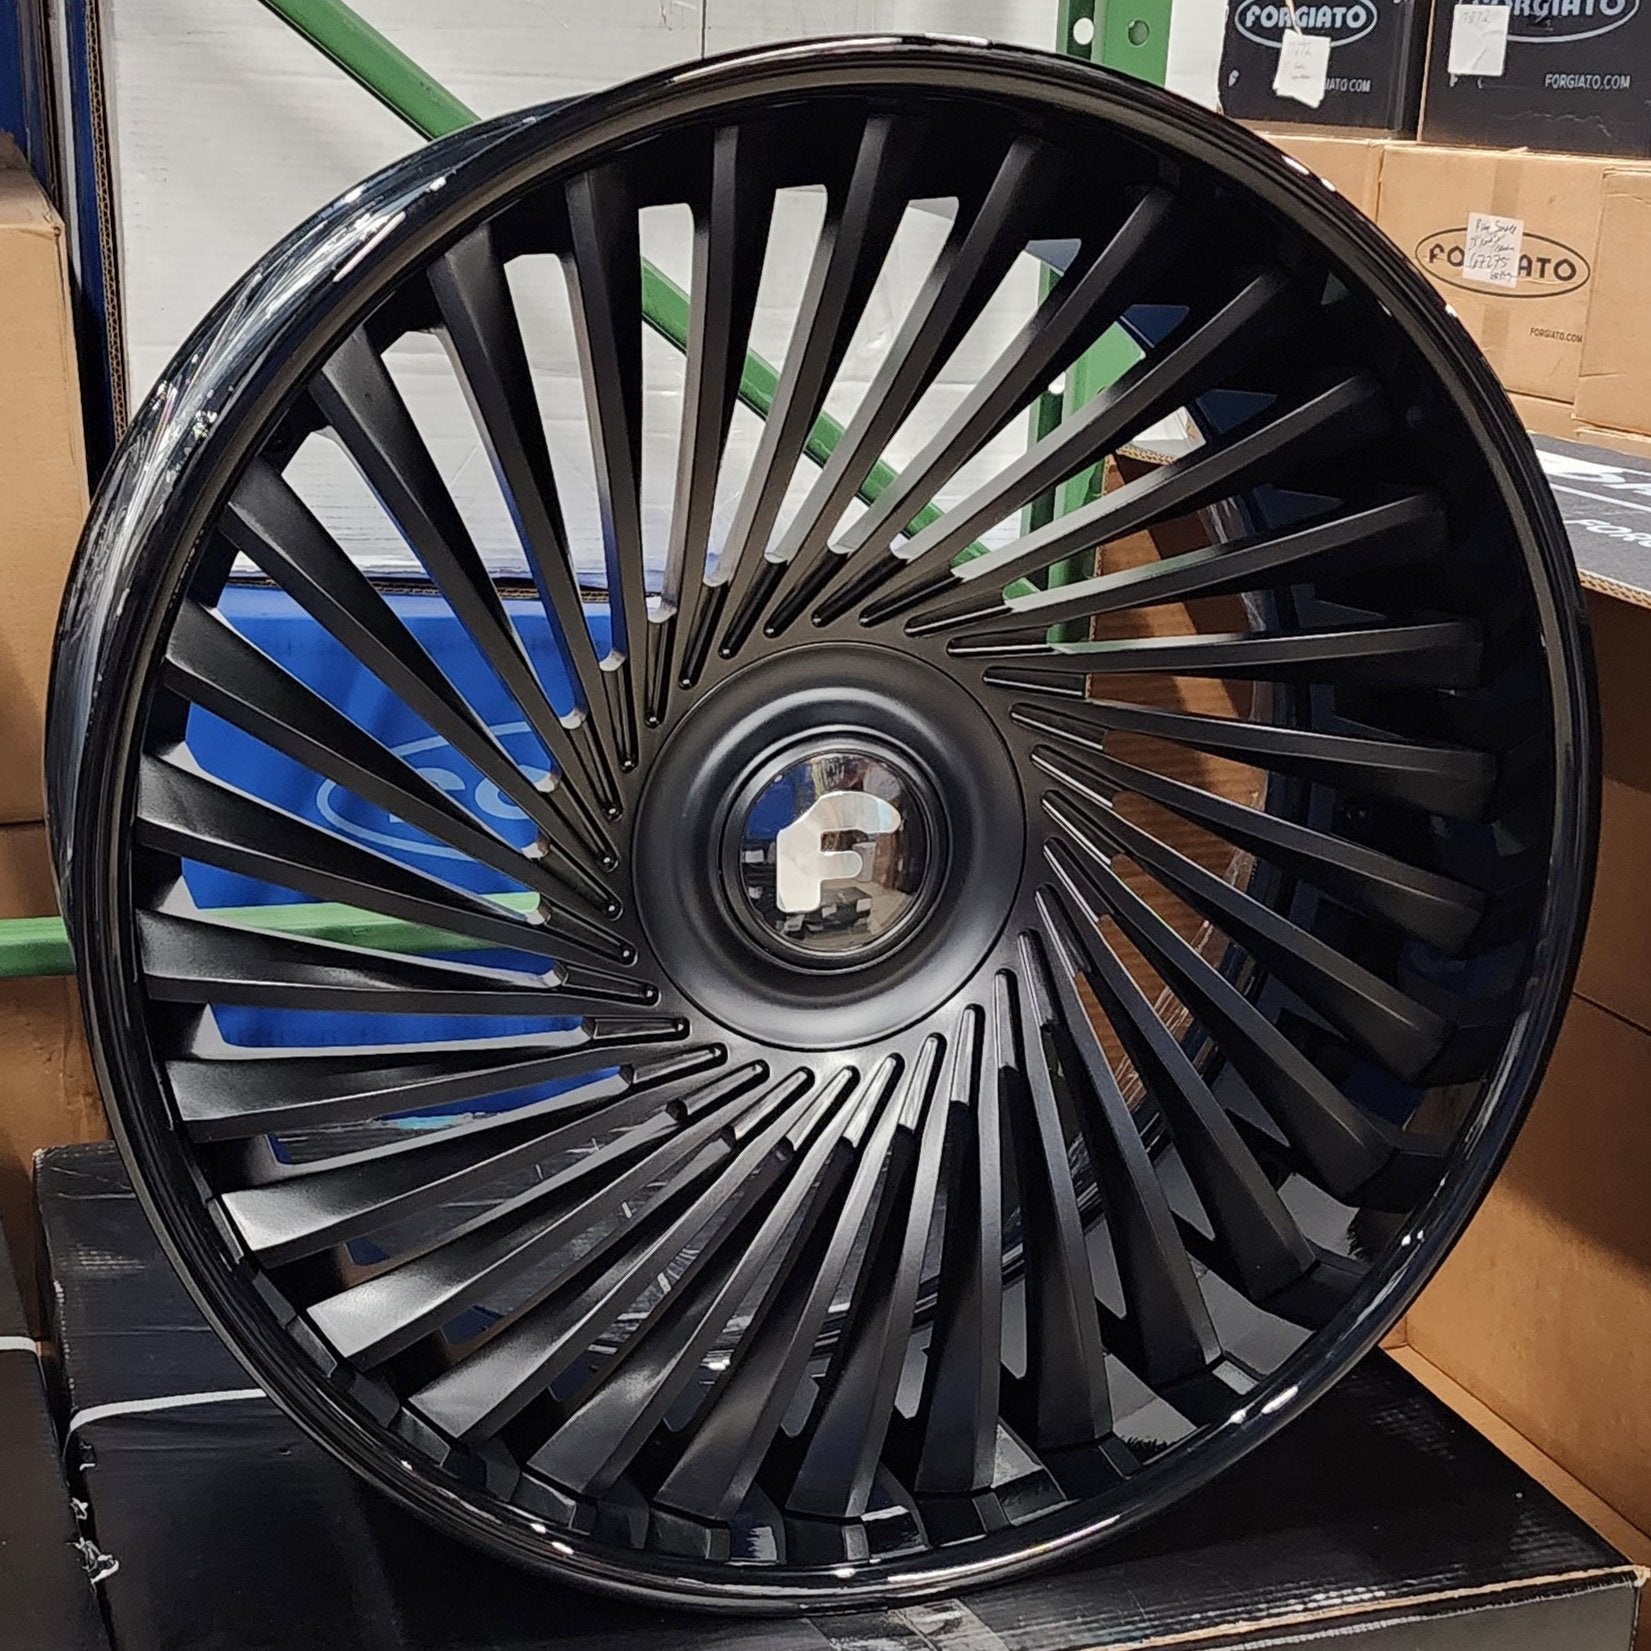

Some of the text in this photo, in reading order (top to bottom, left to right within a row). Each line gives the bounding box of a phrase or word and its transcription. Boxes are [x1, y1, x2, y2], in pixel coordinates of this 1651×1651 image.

[1245, 5, 1367, 28] FORGIATO
[1545, 74, 1631, 90] FORGIATO.COM
[1429, 243, 1577, 281] FOATO
[1530, 327, 1583, 343] FORGIATO.COM
